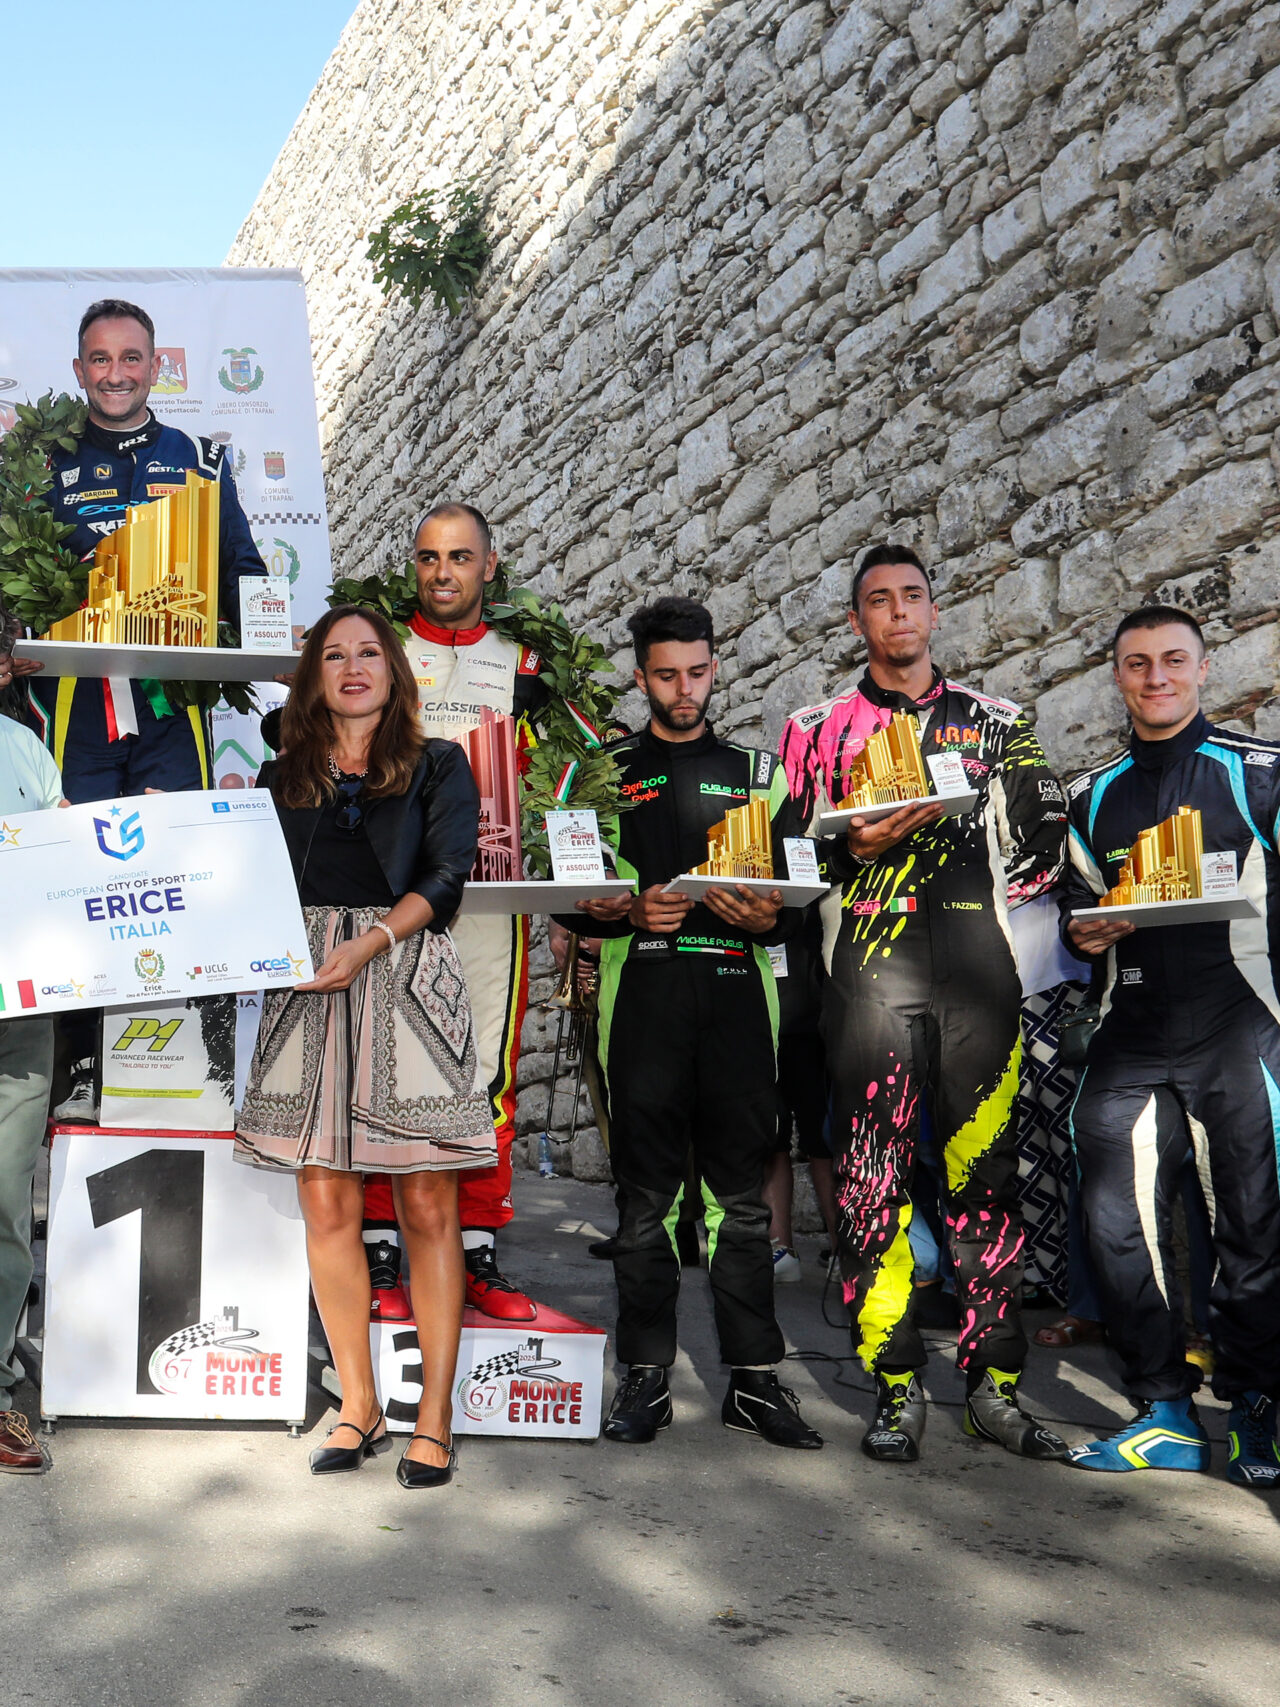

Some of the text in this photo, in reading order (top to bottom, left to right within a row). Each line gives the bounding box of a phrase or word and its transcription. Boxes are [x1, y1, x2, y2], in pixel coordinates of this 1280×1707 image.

[118, 433, 149, 451] HRX
[84, 490, 116, 498] BARDAHL
[254, 631, 286, 639] ASSOLUTO
[801, 710, 826, 724] OMP
[987, 706, 1012, 718] OMP
[1246, 754, 1276, 764] OMP
[232, 801, 267, 810] unesco
[566, 864, 600, 872] ASSOLUTO
[108, 870, 149, 881] CANDIDATE
[46, 871, 213, 901] EUROPEAN CITY OF SPORT 2027
[84, 887, 186, 922] ERICE
[952, 902, 983, 911] FAZZINO
[110, 920, 172, 941] ITALIA
[676, 936, 715, 946] MICHELE
[205, 963, 228, 974] UCLG
[250, 956, 291, 973] aces
[1122, 971, 1142, 982] OMP
[41, 984, 74, 995] aces
[144, 984, 162, 992] Erice
[112, 1018, 185, 1052] P1
[146, 1054, 185, 1062] RACEWEAR
[86, 1149, 205, 1395] 1
[520, 1354, 536, 1362] 2025
[164, 1352, 282, 1380] 67 MONTE
[205, 1375, 282, 1396] ERICE
[509, 1380, 583, 1402] MONTE
[508, 1402, 581, 1424] ERICE
